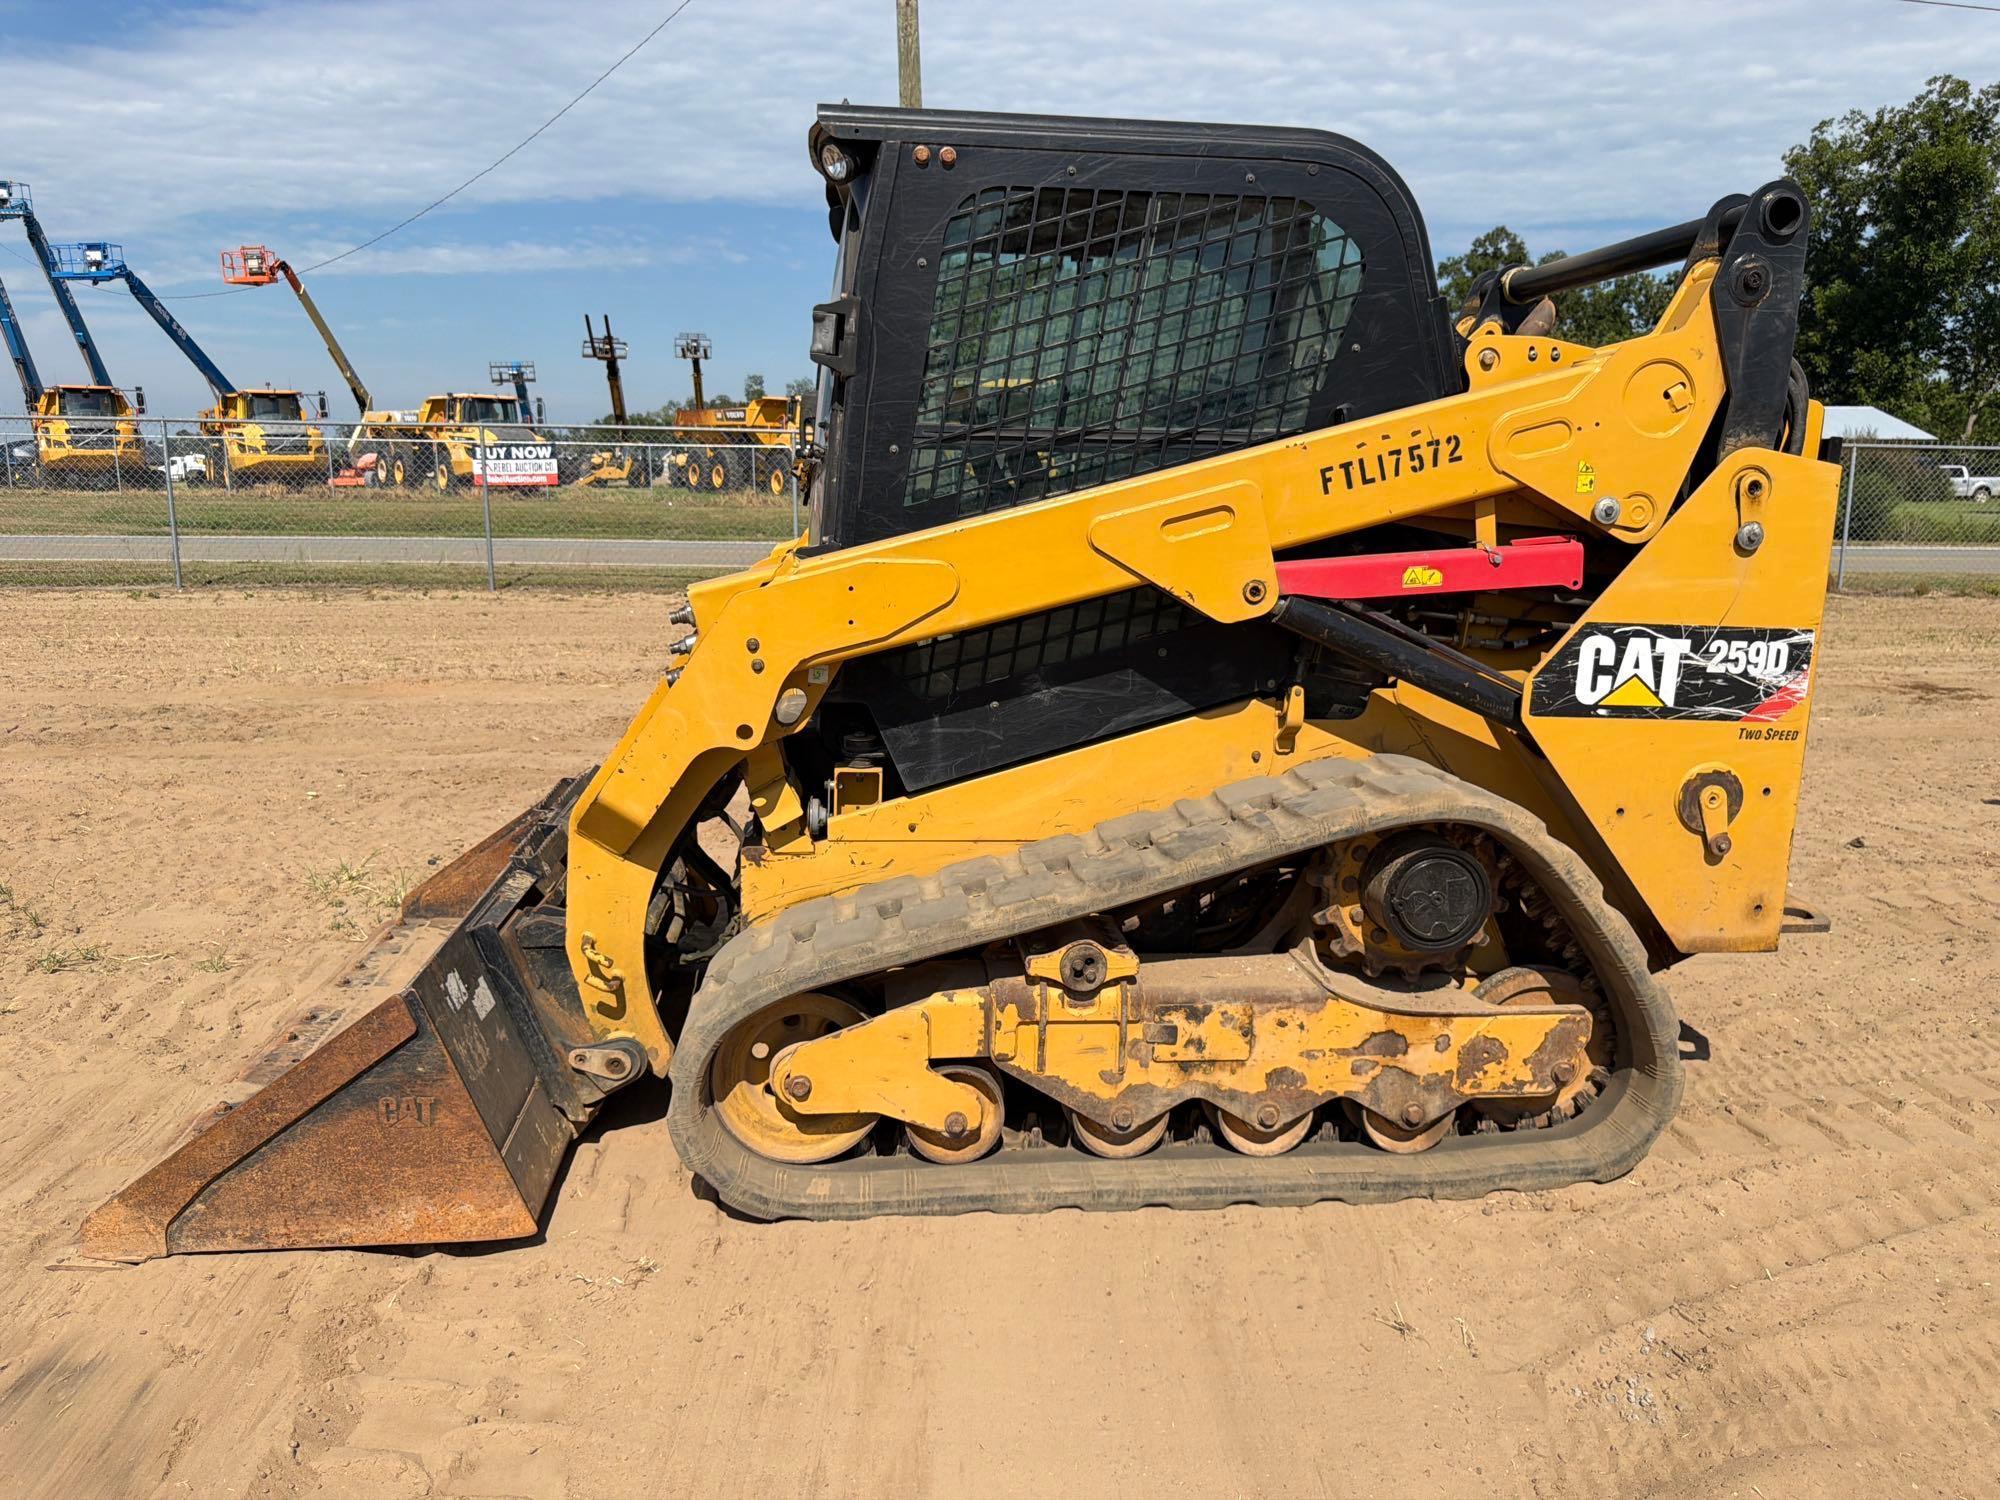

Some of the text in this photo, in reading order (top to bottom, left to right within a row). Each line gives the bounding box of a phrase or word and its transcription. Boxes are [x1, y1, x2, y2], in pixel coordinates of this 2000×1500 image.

[475, 446, 552, 459] BUY NOW
[493, 462, 512, 472] REBEL
[515, 462, 543, 472] AUCTION
[1575, 635, 1789, 707] CAT 259D
[379, 1096, 436, 1129] CAT
